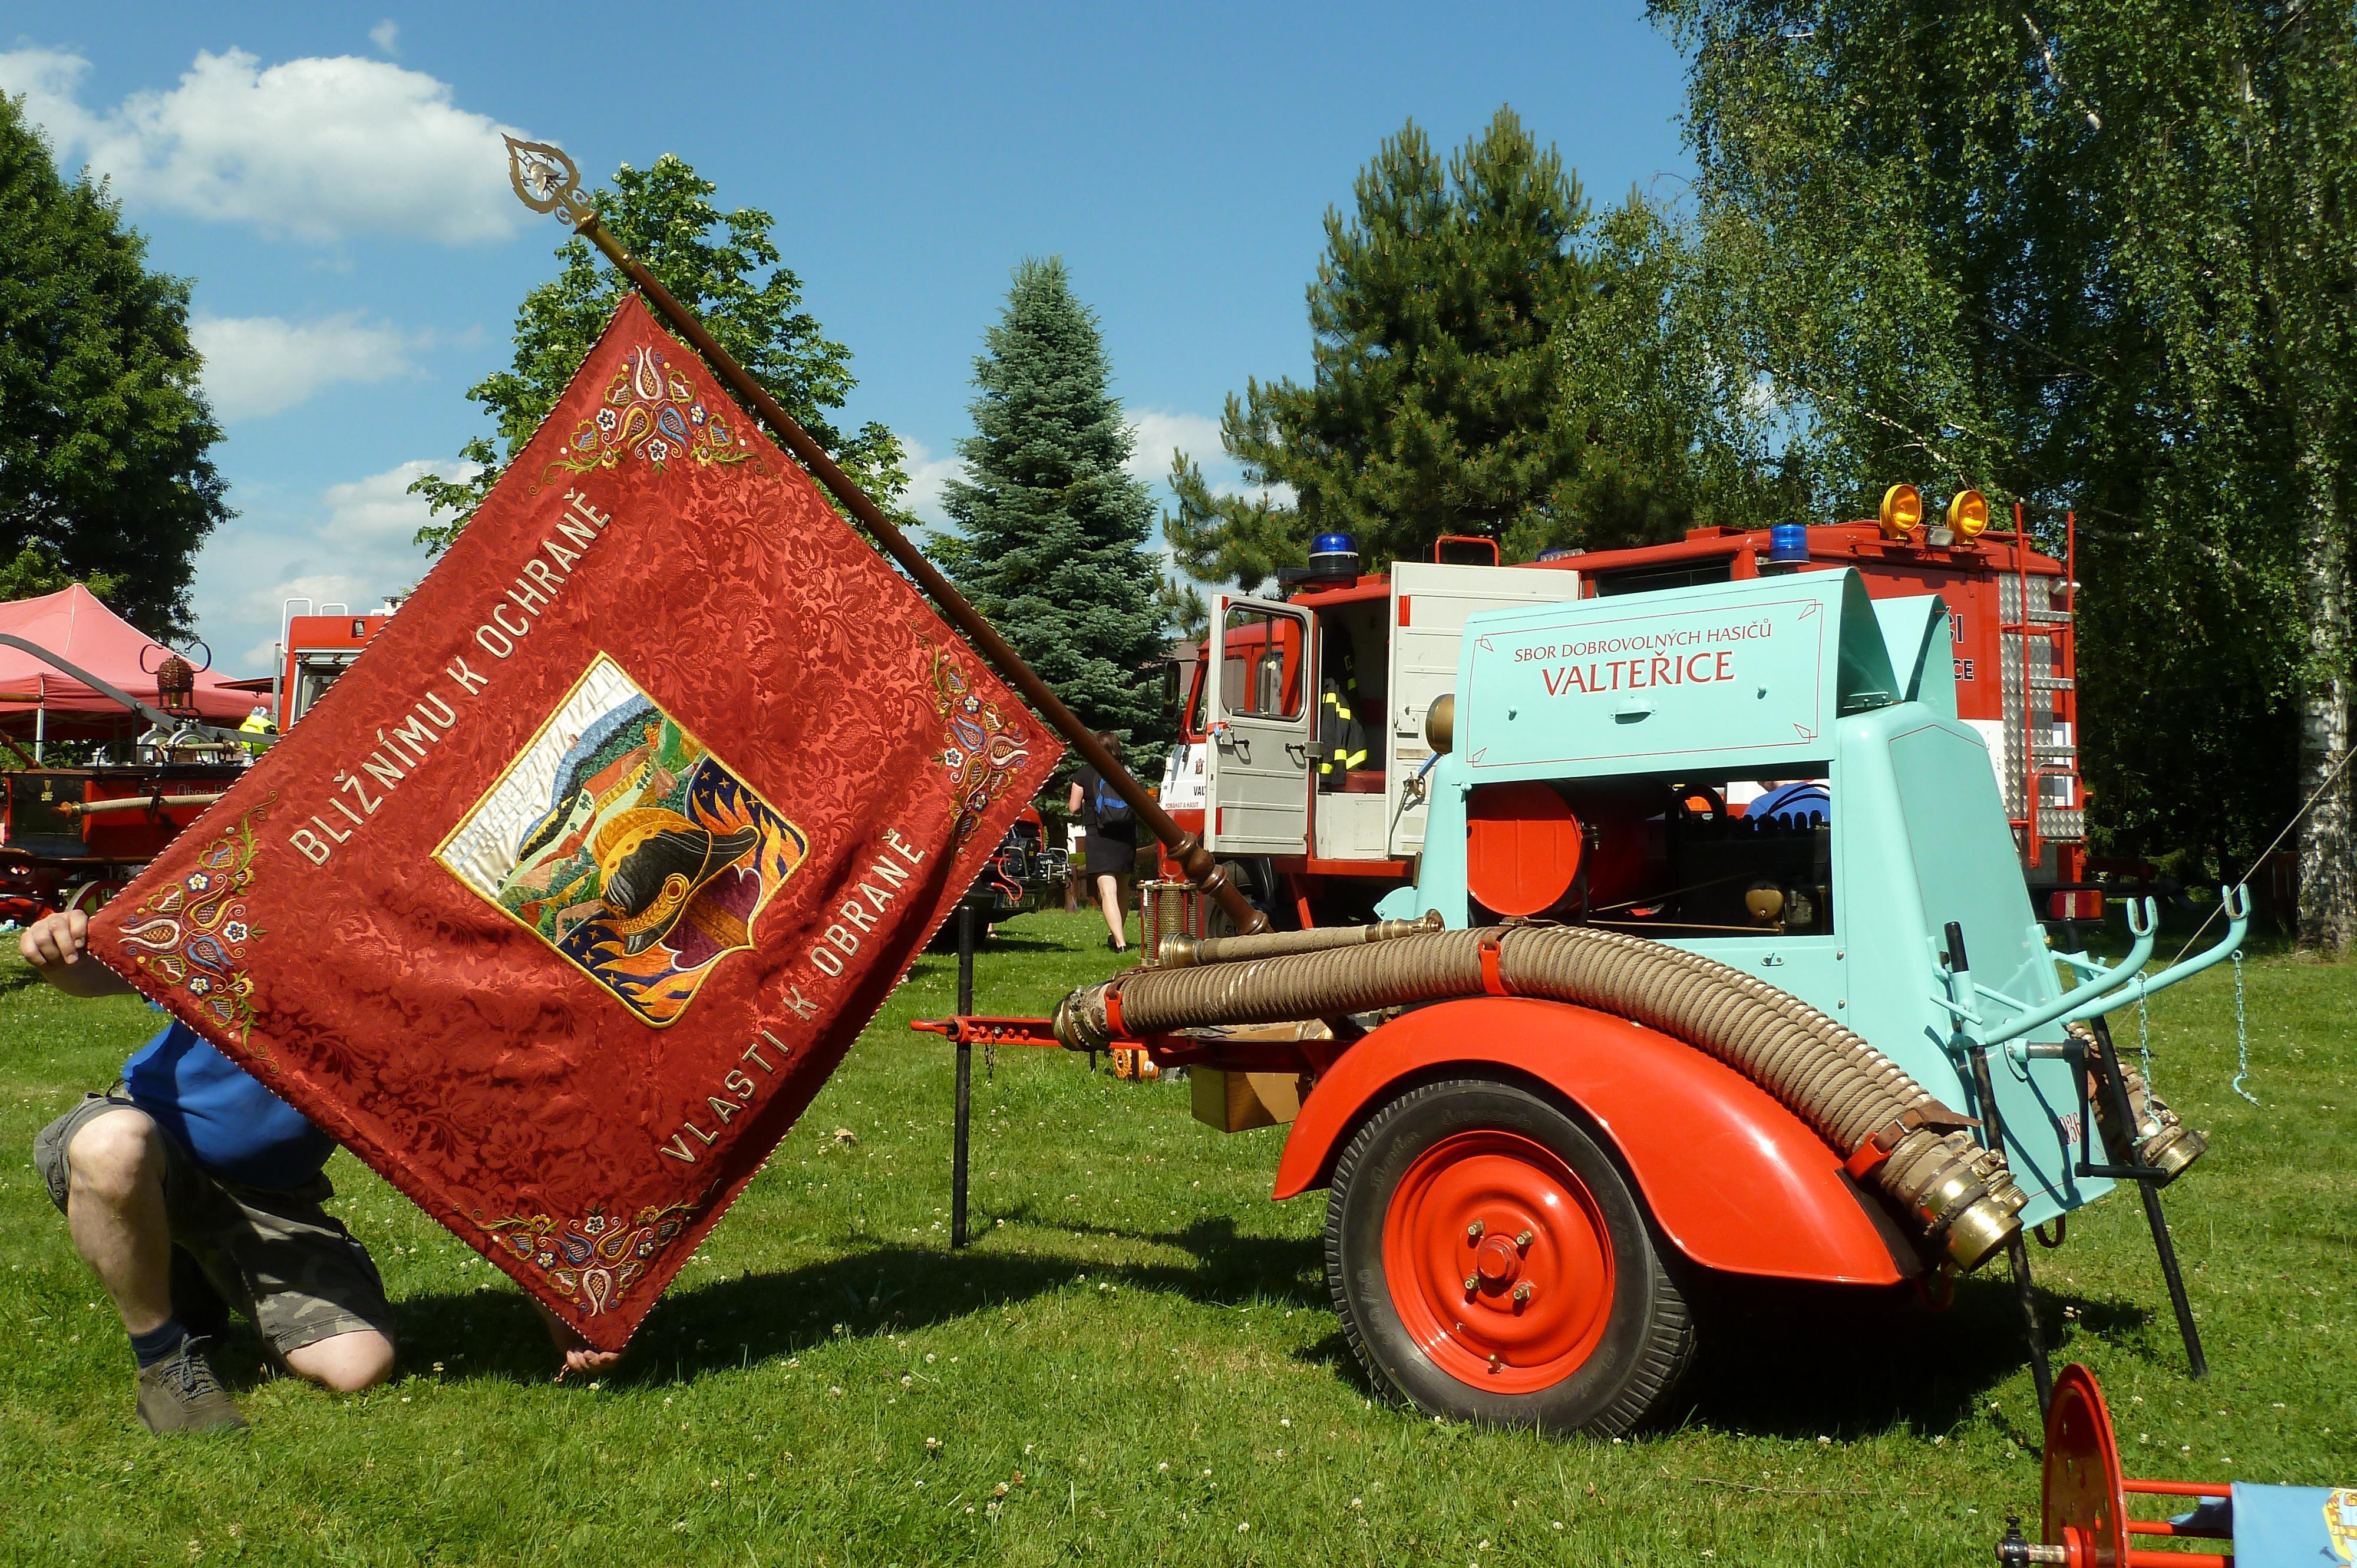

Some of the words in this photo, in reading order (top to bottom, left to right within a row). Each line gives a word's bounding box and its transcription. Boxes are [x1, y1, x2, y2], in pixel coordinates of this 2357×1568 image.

[289, 691, 457, 866] BLIŽNÍMU
[446, 655, 488, 696] K
[476, 487, 610, 659] OCHRANĚ
[1514, 645, 1557, 663] SBOR
[1561, 628, 1701, 658] DOBROVOLNÝCH
[1706, 618, 1772, 643] HASIČŮ
[1541, 650, 1735, 696] VALTEŘICE
[659, 1029, 789, 1163] VLASTI
[782, 985, 818, 1021] K
[810, 827, 925, 978] OBRANĚ
